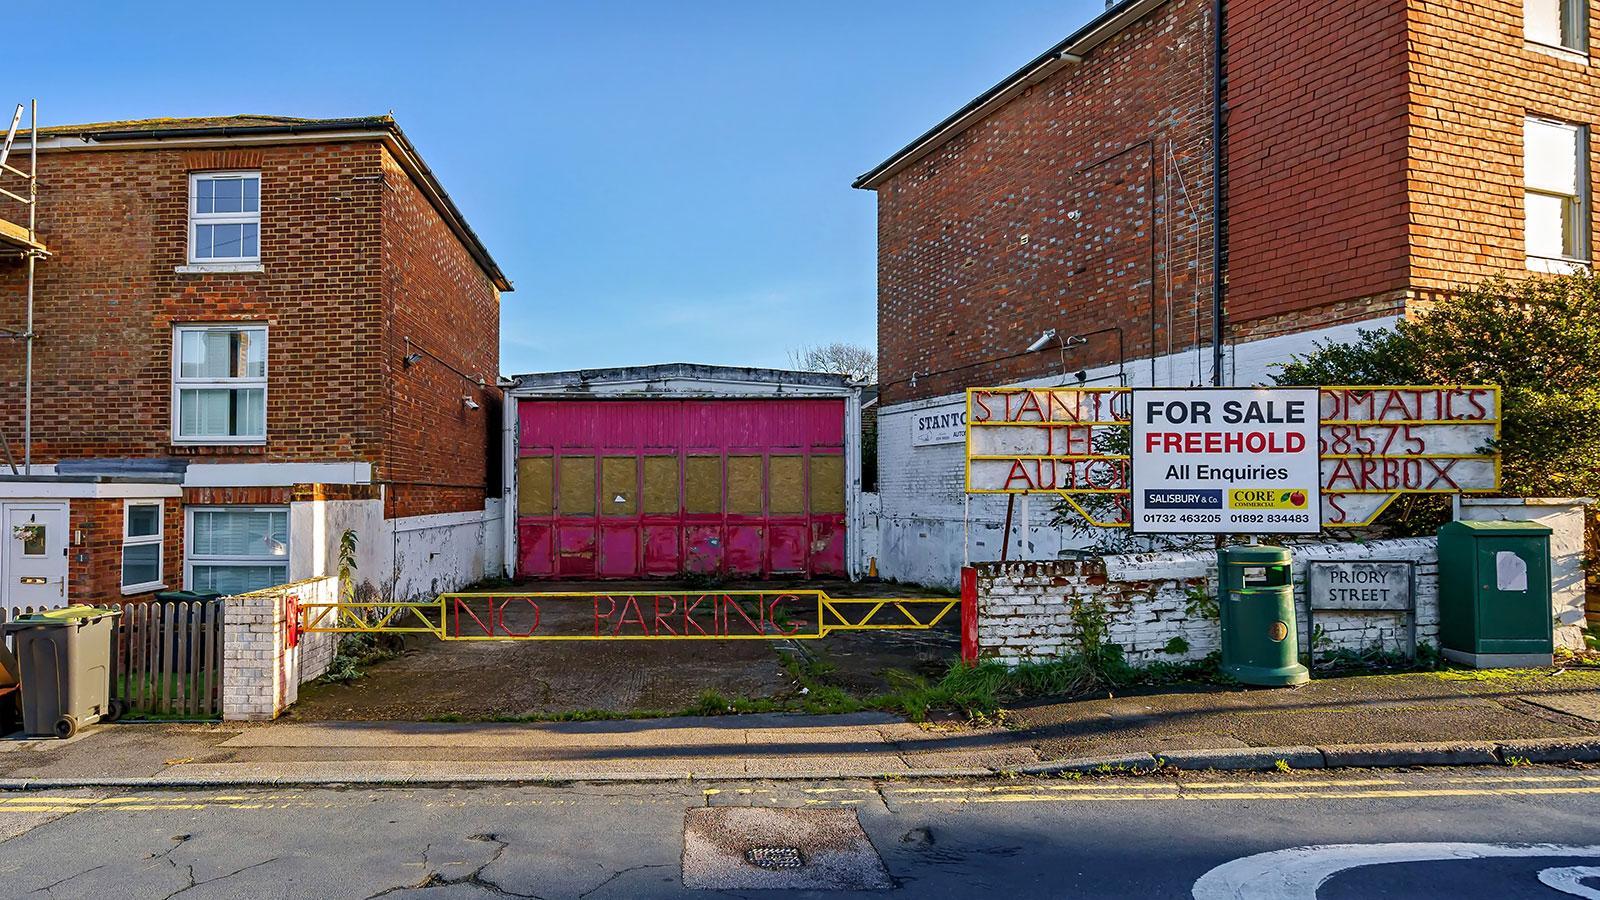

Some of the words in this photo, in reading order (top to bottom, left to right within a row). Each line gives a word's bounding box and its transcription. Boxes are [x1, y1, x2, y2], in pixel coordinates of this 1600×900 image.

[975, 390, 1132, 422] STANTO
[1320, 389, 1487, 421] OMATICS
[1146, 400, 1212, 424] FOR
[1222, 400, 1305, 424] SALE
[1145, 431, 1306, 453] FREEHOLD
[1004, 458, 1132, 490] AUTO
[1321, 458, 1462, 490] ARBOX
[1165, 464, 1190, 480] All
[1197, 464, 1289, 483] Enquiries
[1149, 494, 1200, 504] SALISBURY
[1234, 491, 1275, 502] CORE
[1143, 514, 1176, 523] 01732
[1179, 514, 1221, 523] 463205
[1230, 514, 1264, 523] 01892
[1266, 514, 1309, 523] 834483
[1330, 570, 1389, 584] PRIORY
[1329, 588, 1390, 601] STREET
[454, 594, 540, 637] NO
[593, 594, 808, 637] PARKING
